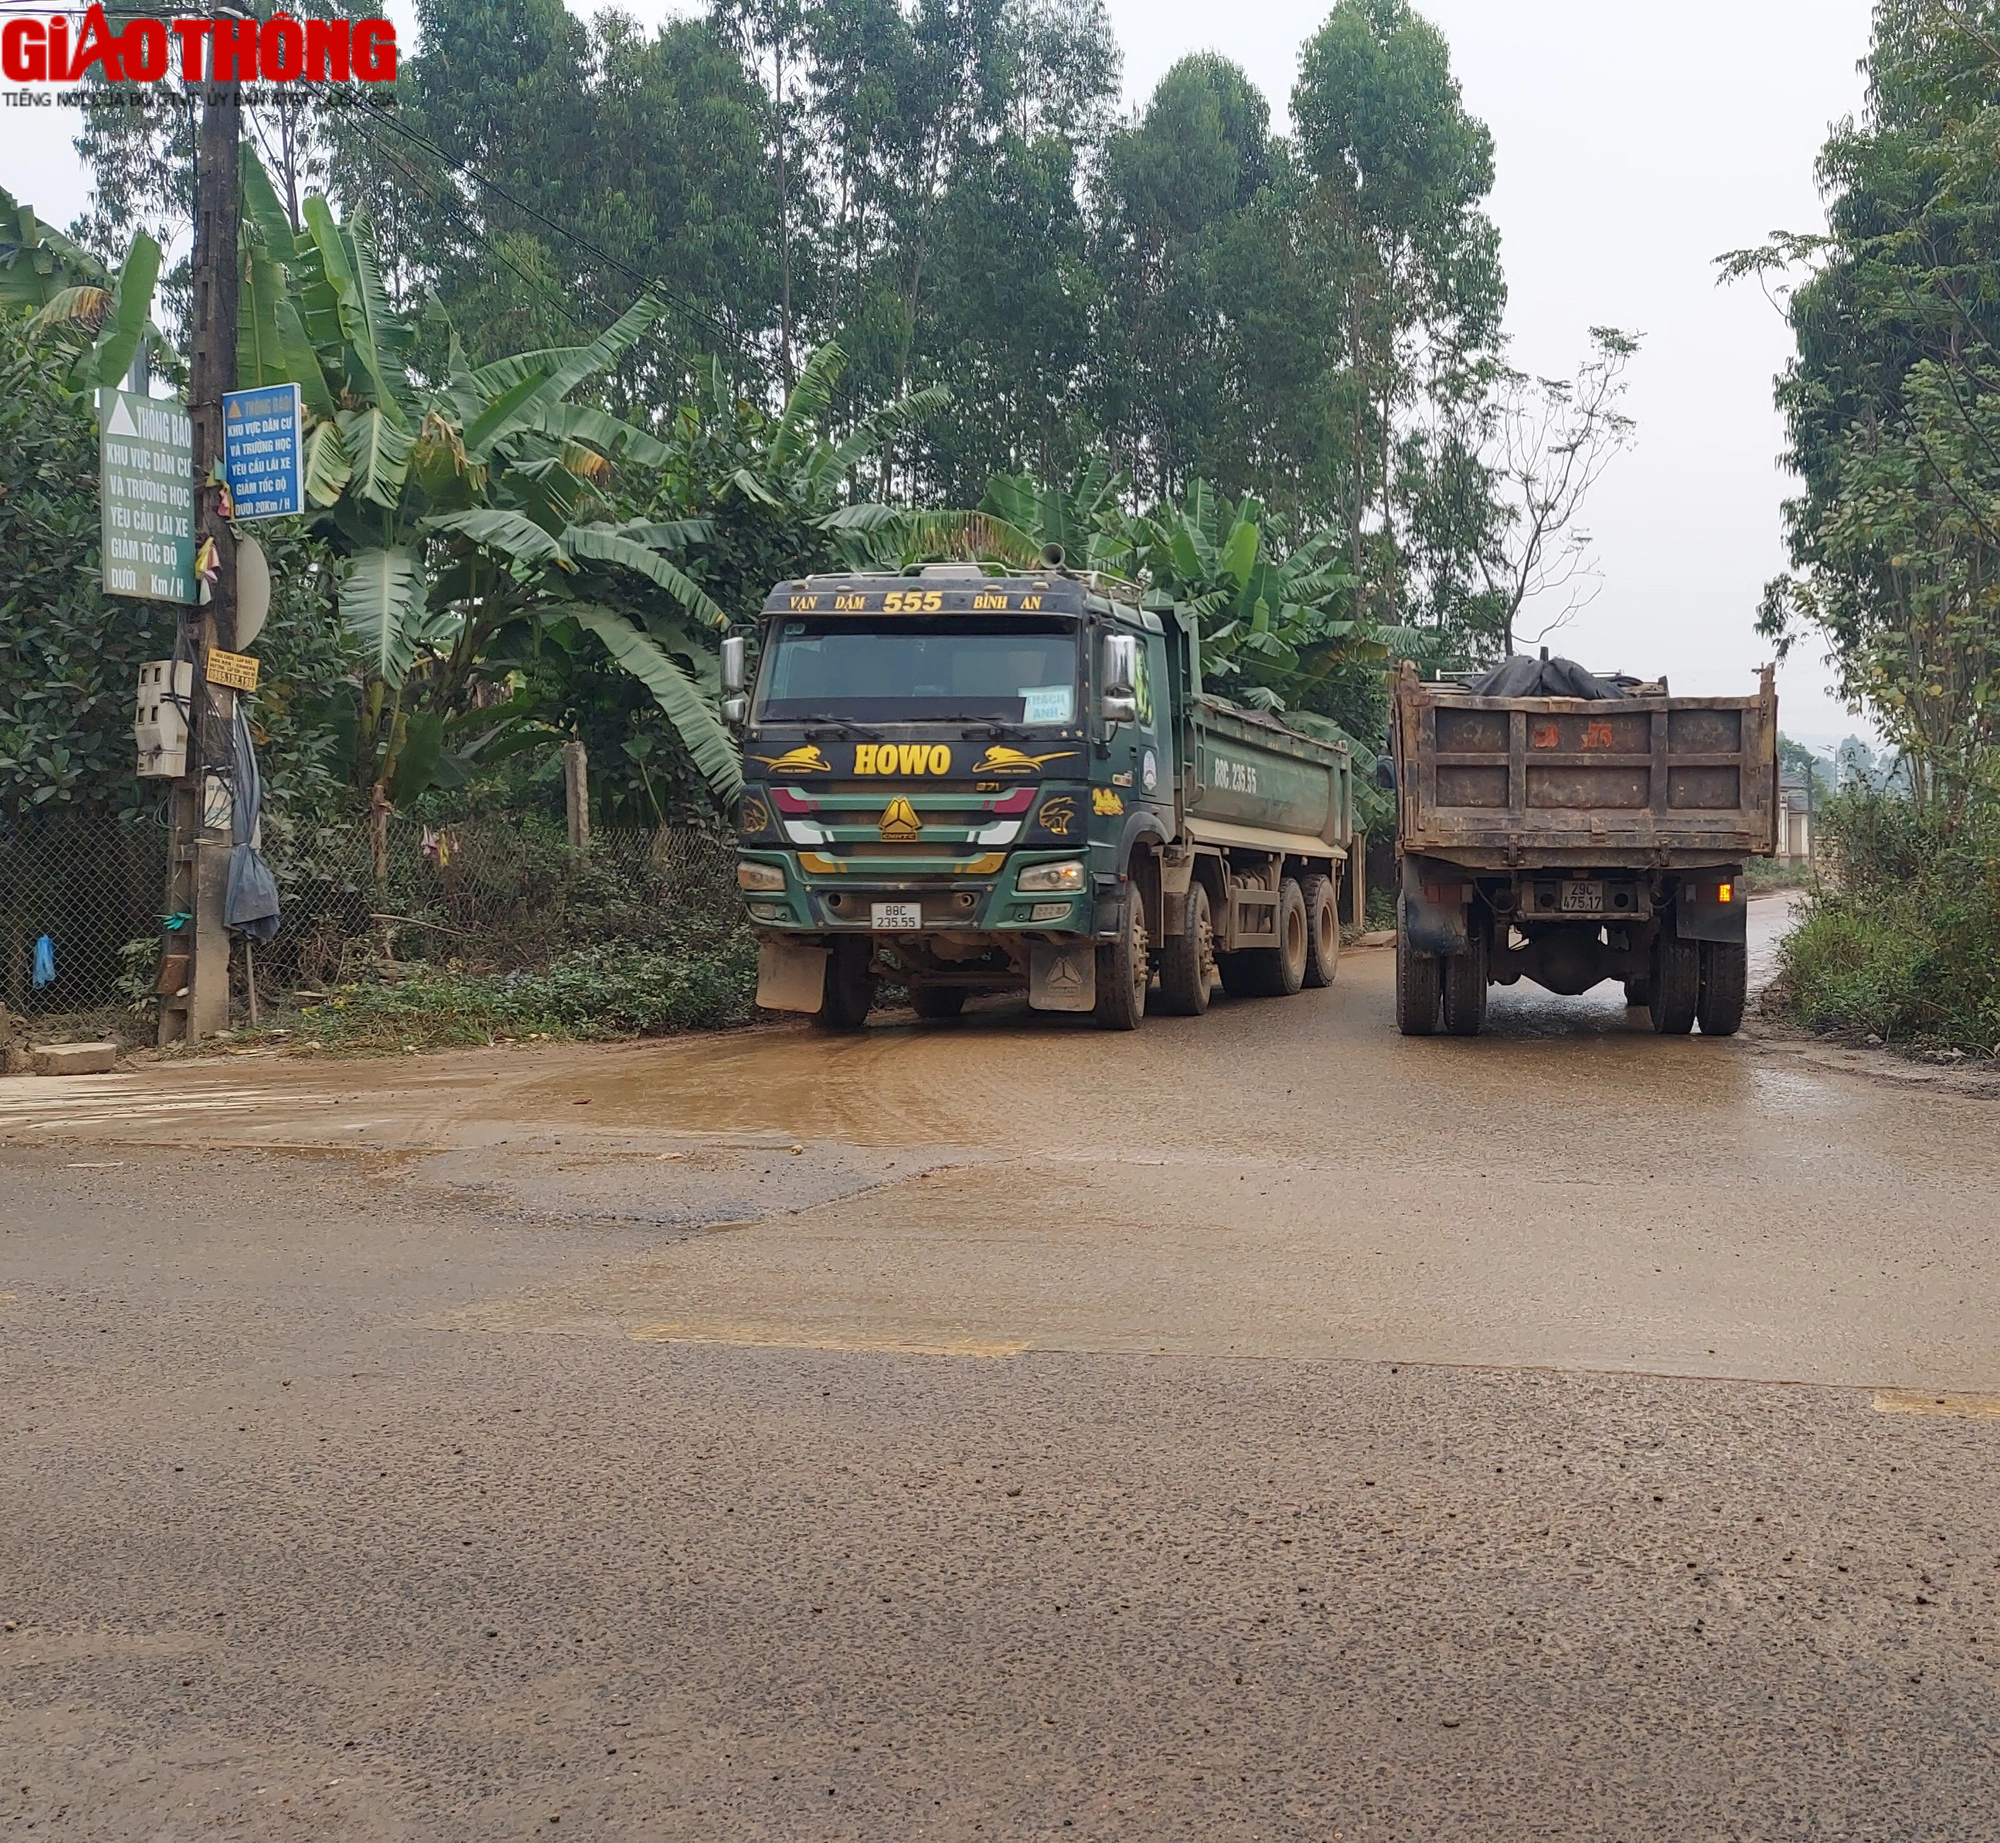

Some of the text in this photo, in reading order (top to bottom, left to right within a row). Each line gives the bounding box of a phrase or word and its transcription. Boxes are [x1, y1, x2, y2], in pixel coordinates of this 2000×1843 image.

[136, 402, 192, 448] THÔNG BÁO
[227, 424, 244, 437] KHU
[245, 421, 261, 436] VỰC
[280, 416, 293, 430] CƯ
[230, 437, 292, 457] VÀ TRƯỜNG HỌC
[106, 443, 128, 466] KHU
[130, 447, 151, 473] VỰC
[177, 456, 192, 478] CƯ
[231, 461, 247, 476] YÊU
[280, 457, 292, 470] XE
[109, 470, 190, 510] VÀ TRƯỜNG HỌC
[258, 475, 274, 493] TỐC
[110, 502, 189, 537] YÊU CẦU LÁI XE
[111, 531, 178, 570] GIẢM TỐC ĐỘ
[111, 565, 136, 591] DƯỚI
[789, 596, 818, 611] VẠN
[882, 592, 943, 612] 555
[973, 593, 1009, 610] BÌNH
[1020, 596, 1043, 610] AN
[853, 744, 951, 775] HOWO
[1571, 883, 1593, 896] 29C
[885, 905, 907, 916] 88C
[876, 917, 916, 928] 235.55
